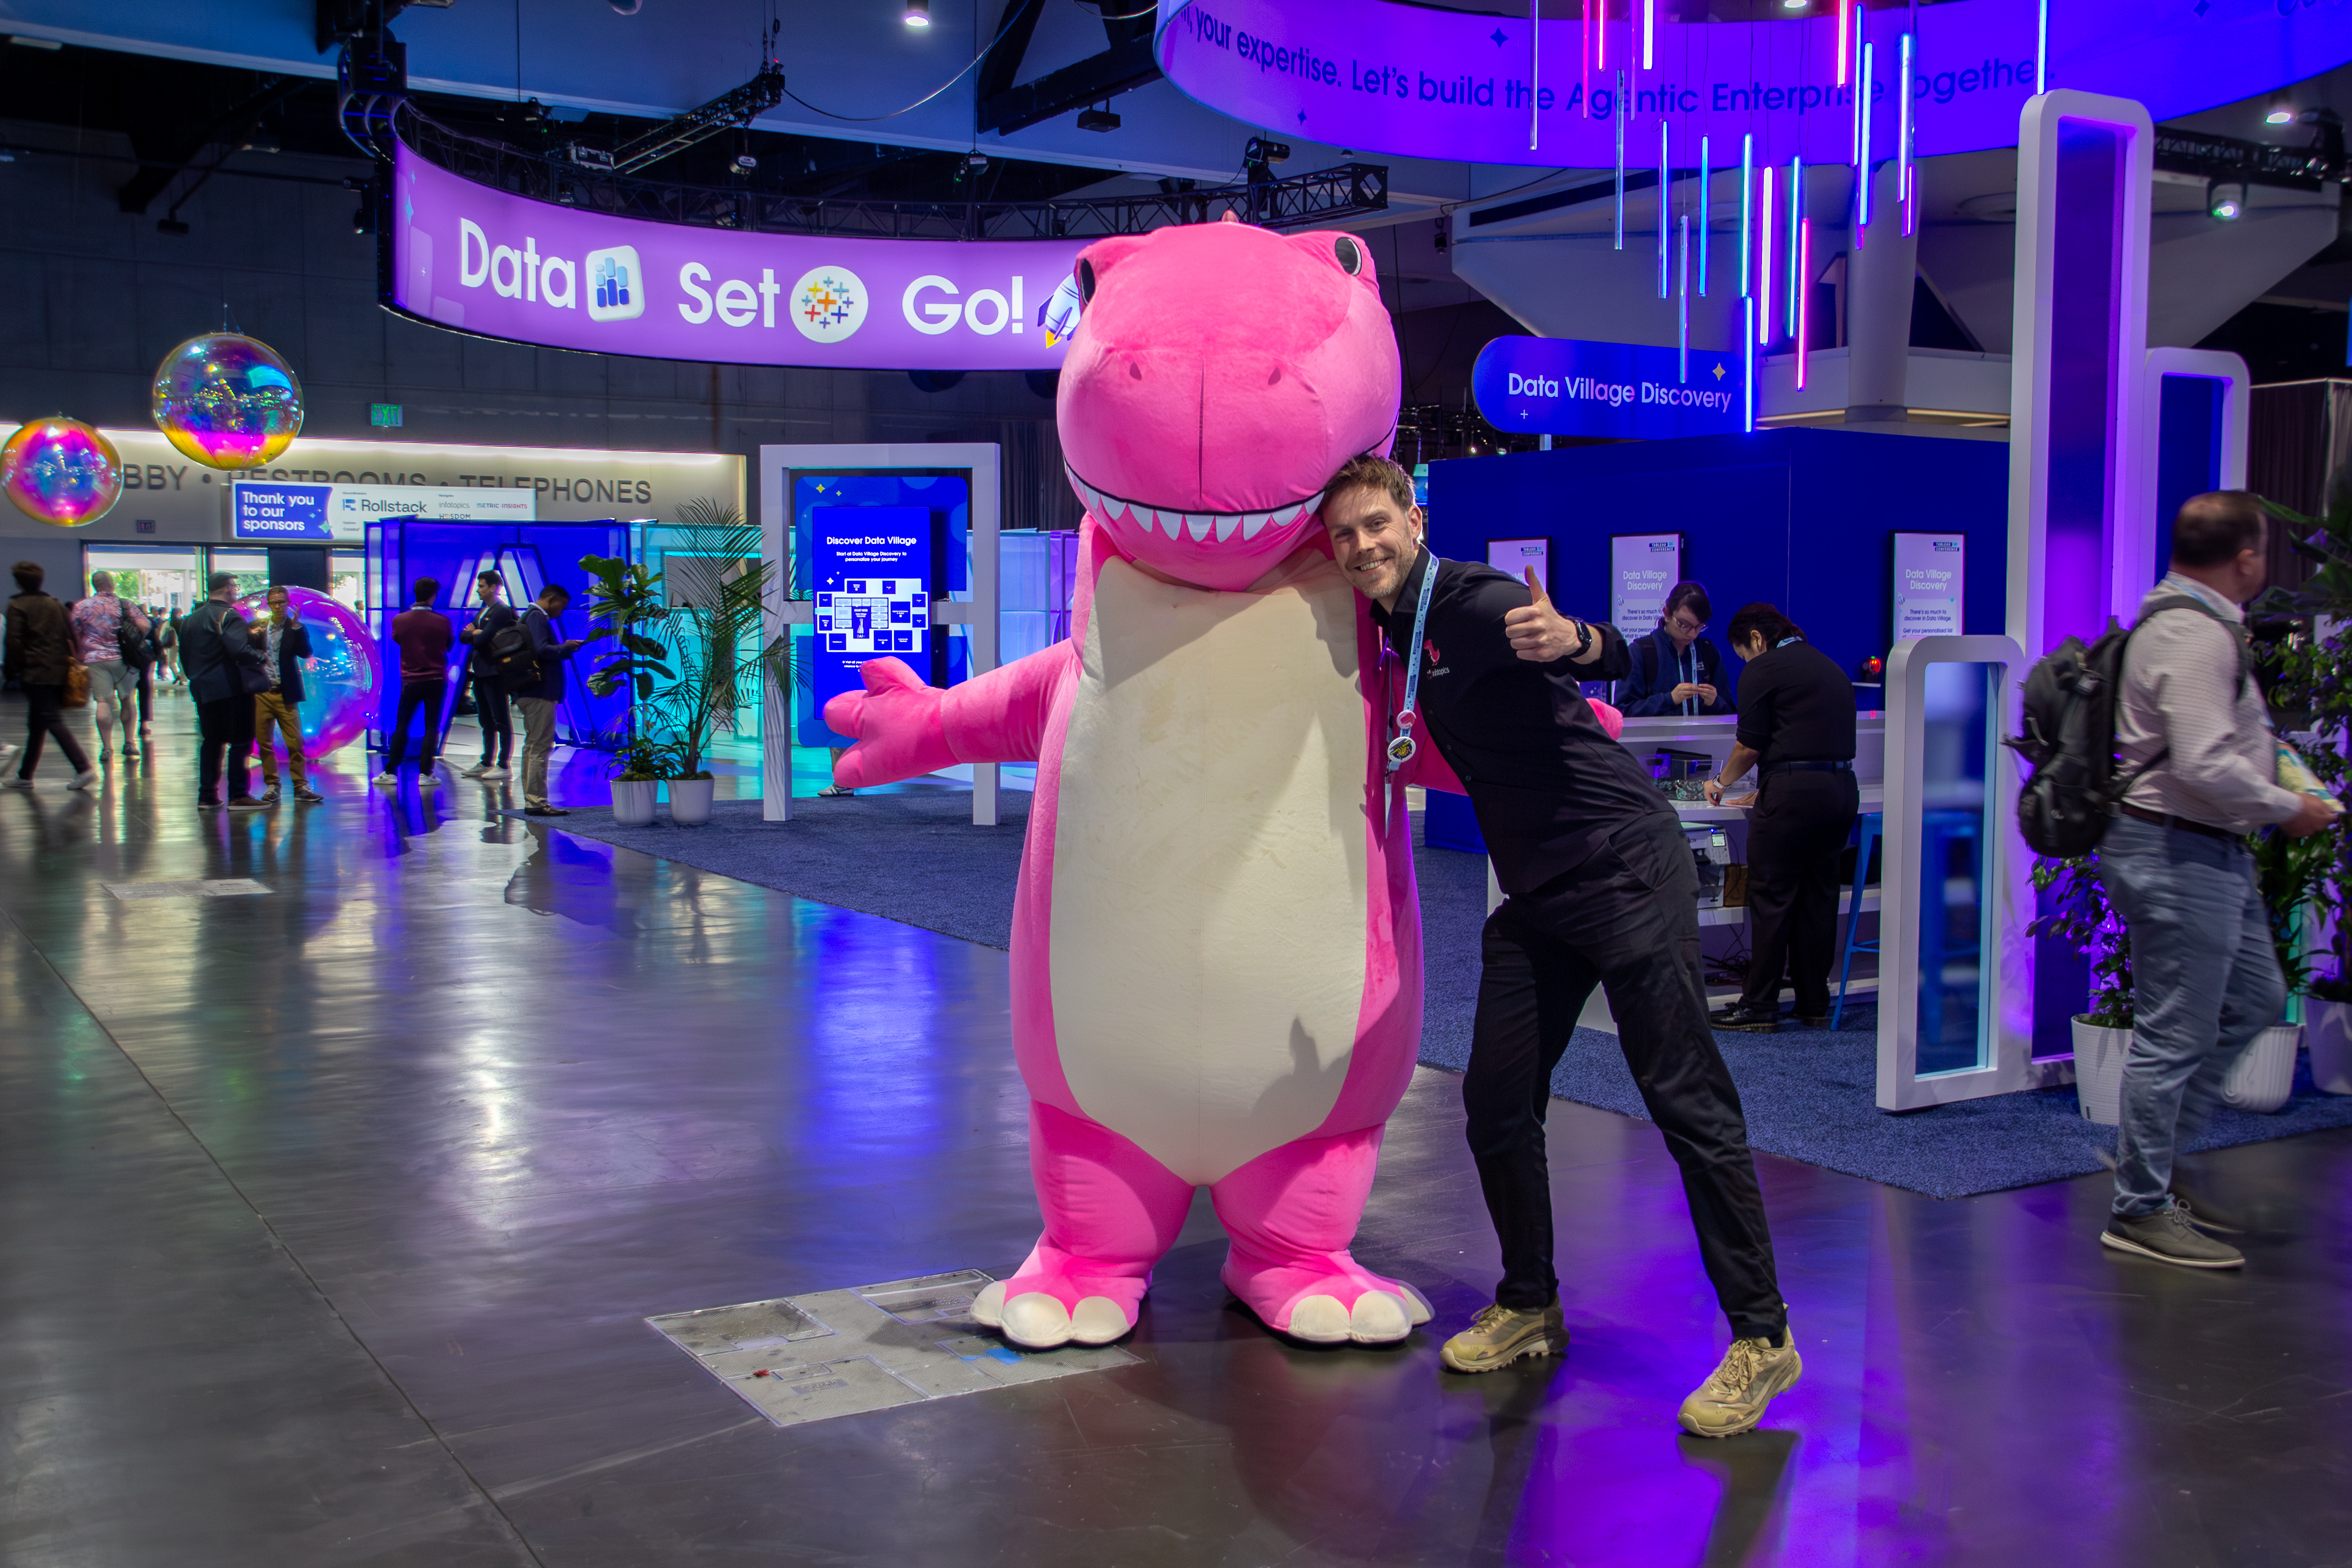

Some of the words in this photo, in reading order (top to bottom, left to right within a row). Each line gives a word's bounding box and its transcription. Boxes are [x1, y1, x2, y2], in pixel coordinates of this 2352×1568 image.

[1196, 7, 1231, 49] your
[1237, 31, 1342, 87] expertise.
[1352, 60, 1409, 99] Let's
[1419, 71, 1494, 107] build
[1505, 79, 1555, 110] the
[1899, 58, 2055, 104] ogethe.
[461, 218, 576, 309] Data
[679, 262, 780, 328] Set
[902, 275, 1023, 336] Go!
[1508, 373, 1558, 398] Data
[1565, 376, 1636, 407] Village
[1641, 381, 1732, 413] Discovery
[373, 404, 401, 425] EXIT
[123, 463, 188, 490] BBY
[242, 491, 285, 504] Thank
[288, 496, 314, 507] you
[243, 504, 258, 516] to
[261, 507, 285, 517] our
[361, 499, 428, 513] Rollstack
[439, 501, 470, 510] infotopics
[243, 520, 306, 532] sponsors
[827, 536, 863, 545] Discover
[864, 536, 885, 545] Data
[887, 536, 917, 546] Village
[1514, 572, 1525, 582] Vill
[1623, 570, 1640, 580] Data
[1642, 570, 1667, 581] Village
[1905, 569, 1924, 579] Data
[1925, 569, 1952, 581] Village
[1627, 581, 1663, 591] Discovery
[1910, 580, 1947, 592] Discovery
